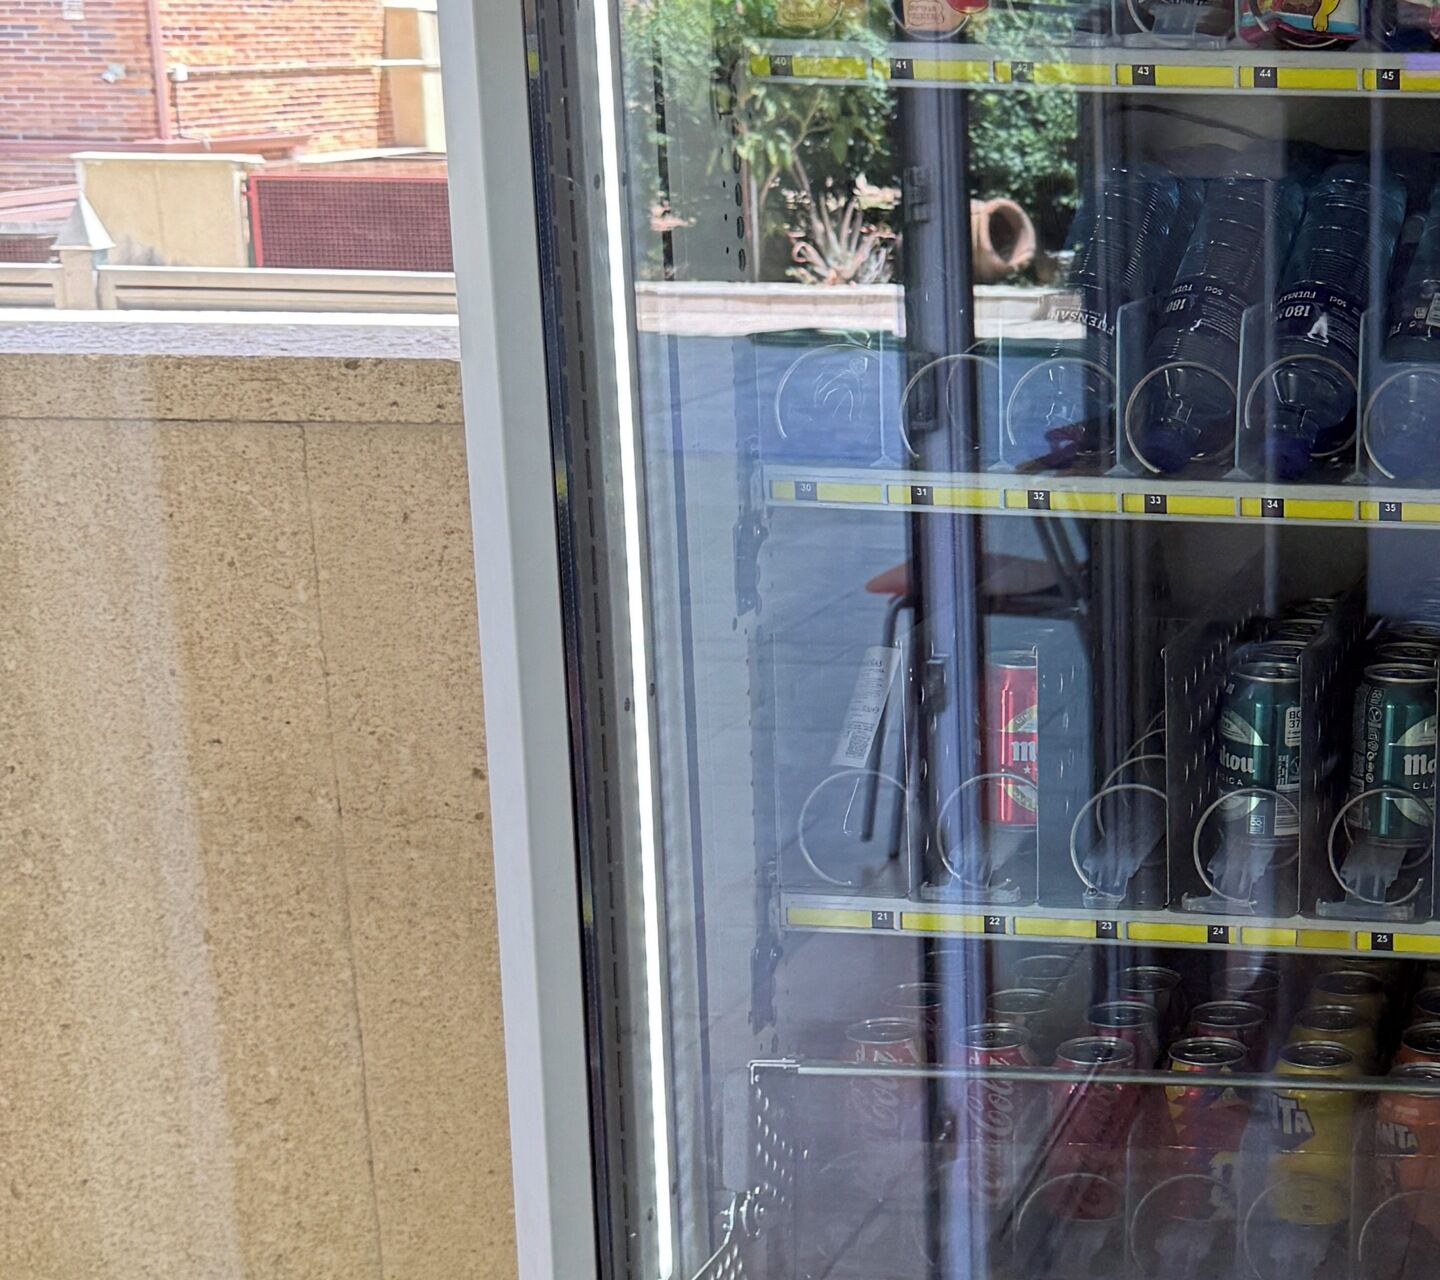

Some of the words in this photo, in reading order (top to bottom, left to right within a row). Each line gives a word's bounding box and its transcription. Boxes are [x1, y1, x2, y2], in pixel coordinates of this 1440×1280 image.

[896, 61, 907, 69] 41
[1382, 72, 1394, 81] 45
[917, 487, 927, 496] 31
[1034, 492, 1044, 500] 32
[1150, 496, 1161, 504] 33
[1267, 500, 1278, 508] 34
[1385, 503, 1396, 512] 35
[877, 912, 888, 921] 21
[989, 917, 1000, 926] 22
[1101, 921, 1112, 930] 23
[1213, 927, 1223, 936] 24
[1377, 934, 1388, 943] 25
